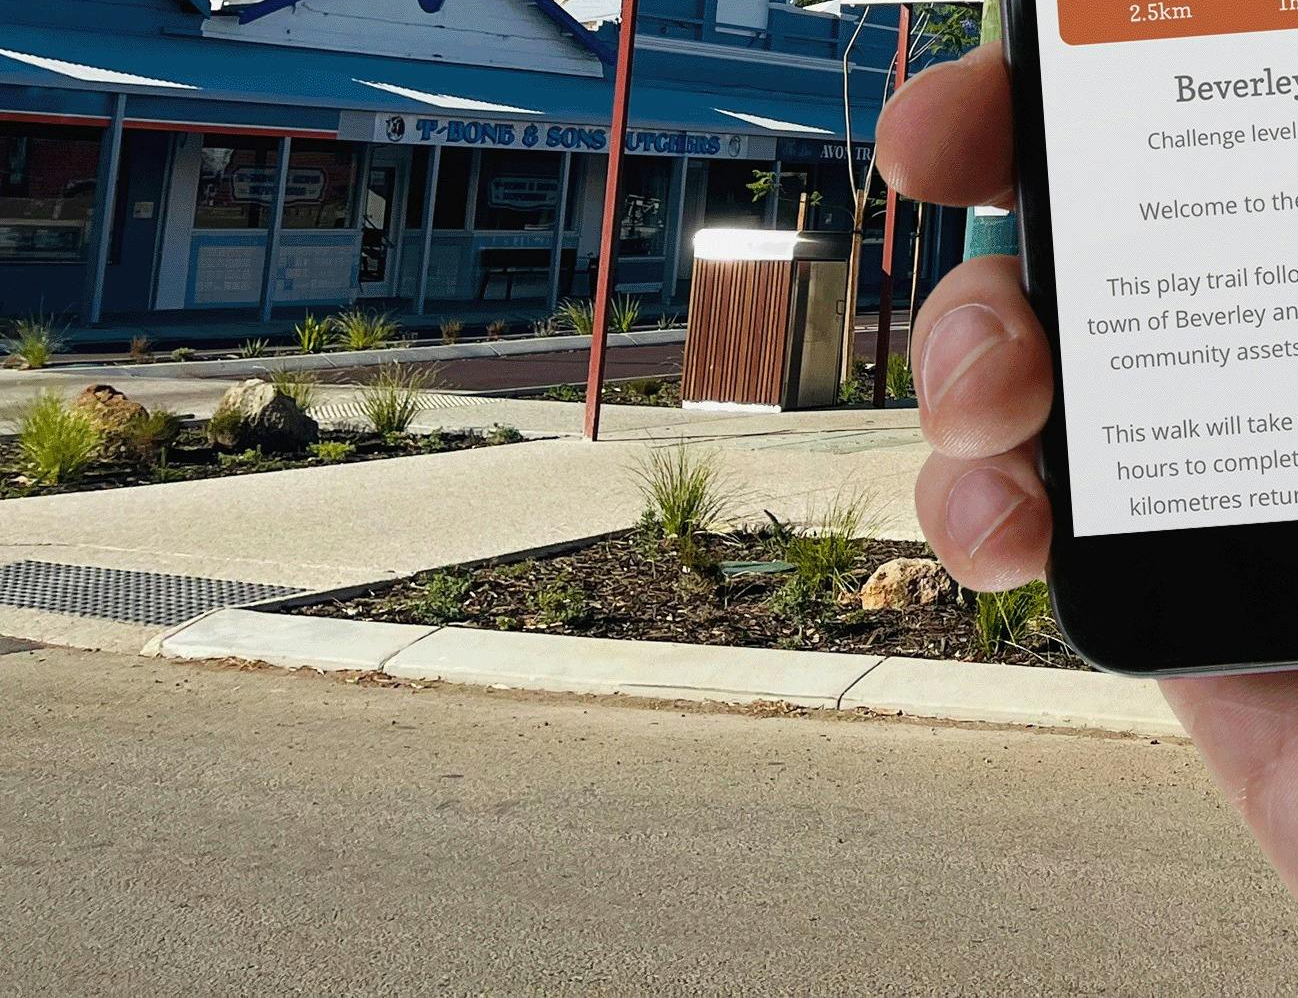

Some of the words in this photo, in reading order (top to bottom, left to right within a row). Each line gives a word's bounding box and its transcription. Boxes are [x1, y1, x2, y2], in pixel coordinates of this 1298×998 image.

[1129, 1, 1193, 22] 2.5km
[416, 118, 516, 146] T-BONE
[522, 123, 539, 148] &
[545, 125, 607, 151] SONS
[624, 130, 721, 155] UTCHERS
[1147, 128, 1245, 150] Challenge
[820, 144, 848, 159] AVO
[1139, 199, 1237, 221] Welcome
[1244, 196, 1265, 213] to
[1106, 276, 1150, 296] This
[1157, 273, 1200, 299] play
[1206, 267, 1248, 290] trail
[1087, 317, 1140, 335] town
[1147, 309, 1169, 331] of
[1175, 304, 1266, 328] Beverley
[1110, 344, 1230, 370] community
[1101, 424, 1145, 444] This
[1151, 418, 1200, 441] walk
[1205, 415, 1241, 436] will
[1247, 412, 1292, 434] take
[1117, 460, 1179, 480] hours
[1184, 458, 1206, 475] to
[1129, 493, 1242, 516] kilometres
